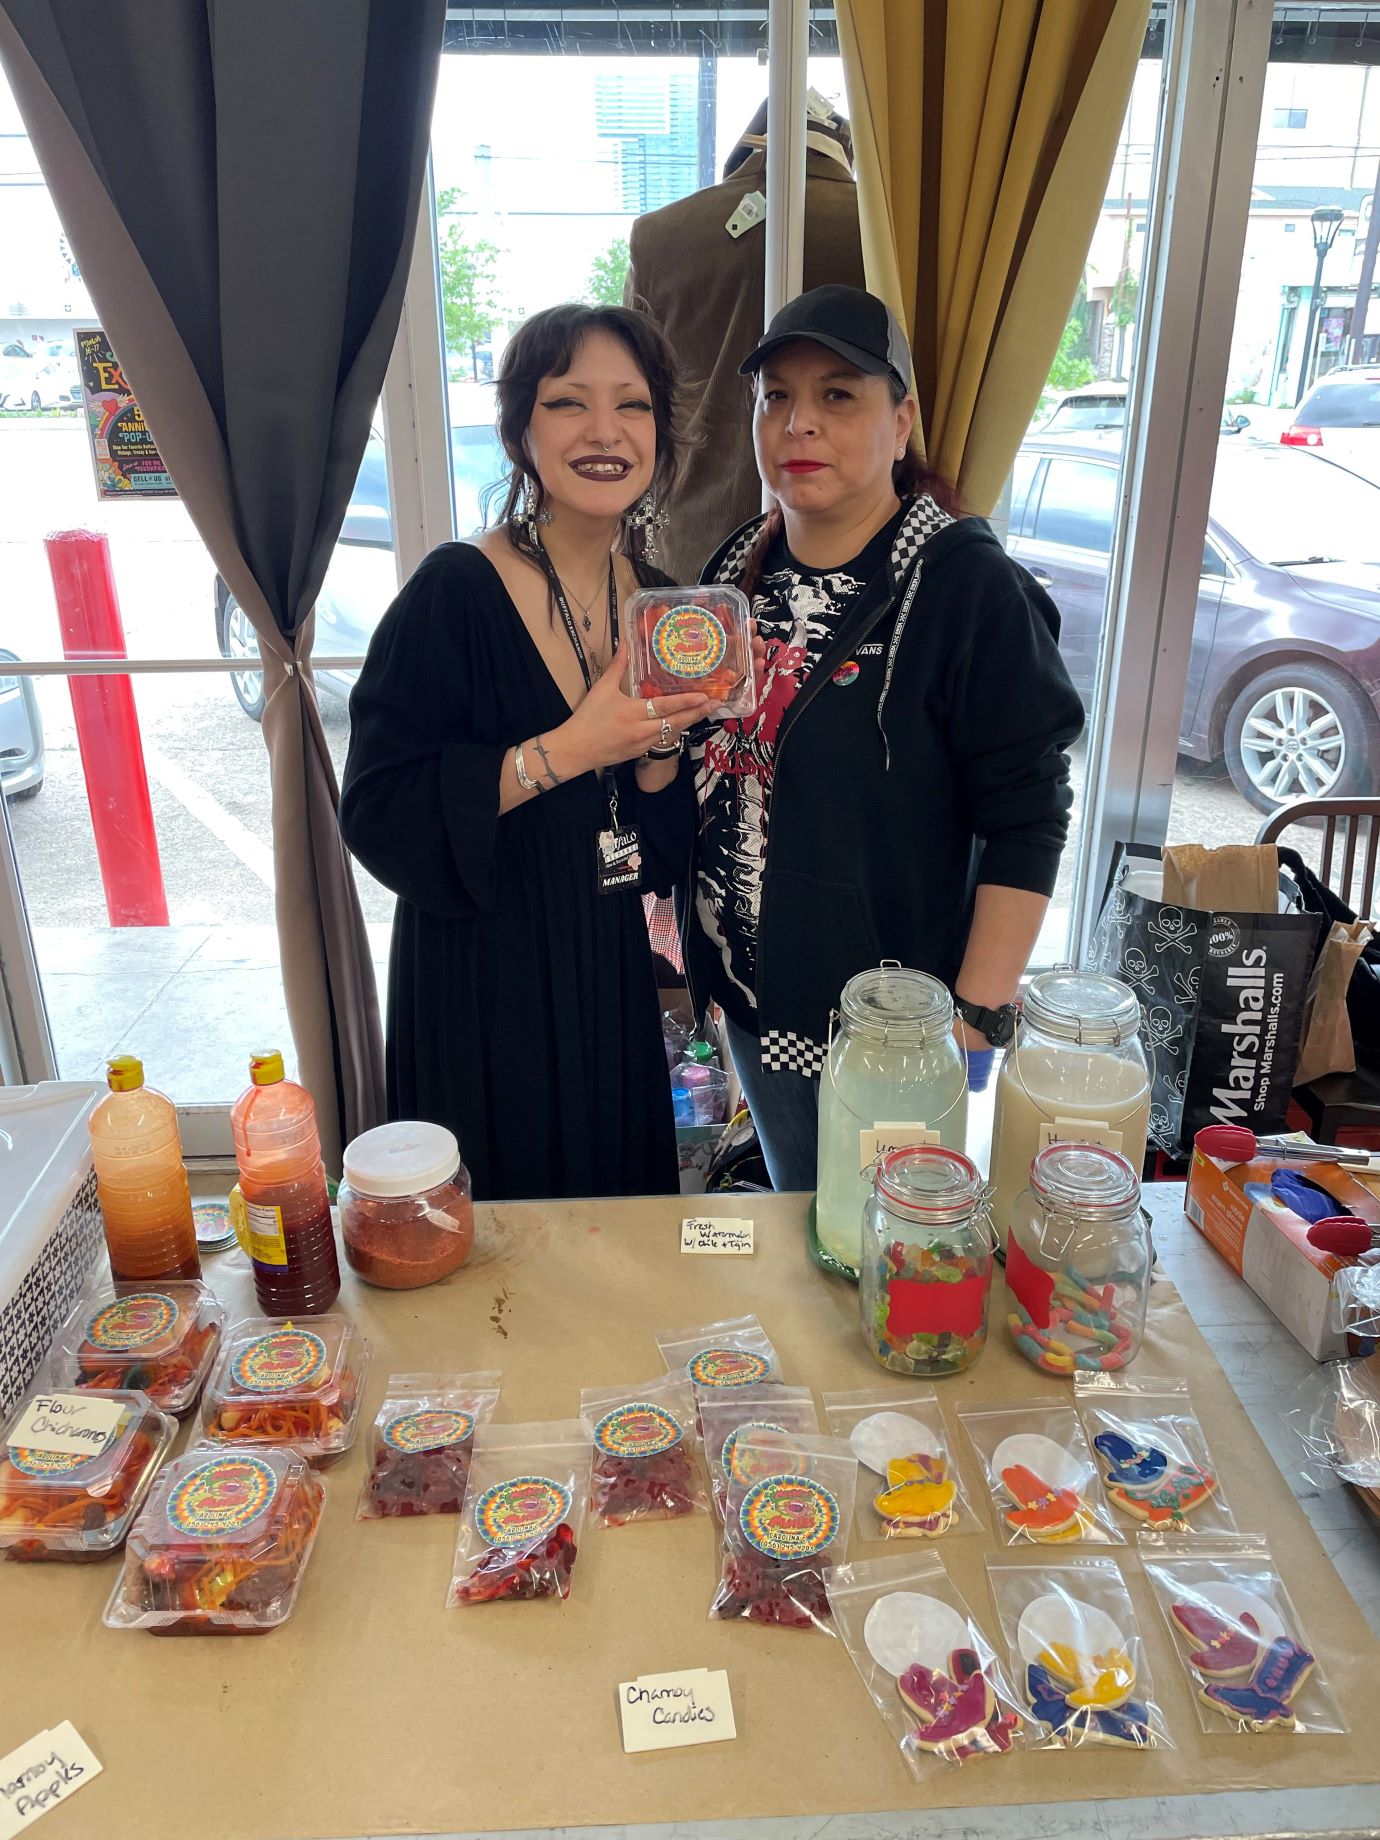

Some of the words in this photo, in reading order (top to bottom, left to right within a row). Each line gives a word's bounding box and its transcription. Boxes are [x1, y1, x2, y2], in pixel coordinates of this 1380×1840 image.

[118, 422, 149, 432] ANNI
[856, 643, 884, 656] VANS
[603, 872, 639, 887] MANAGER
[1260, 972, 1284, 1075] Marshalls.com
[1209, 949, 1267, 1126] Marshalls
[1254, 1077, 1271, 1111] Shop
[686, 1219, 716, 1231] Fresh
[35, 1399, 87, 1416] Flour
[652, 1704, 715, 1725] Candies
